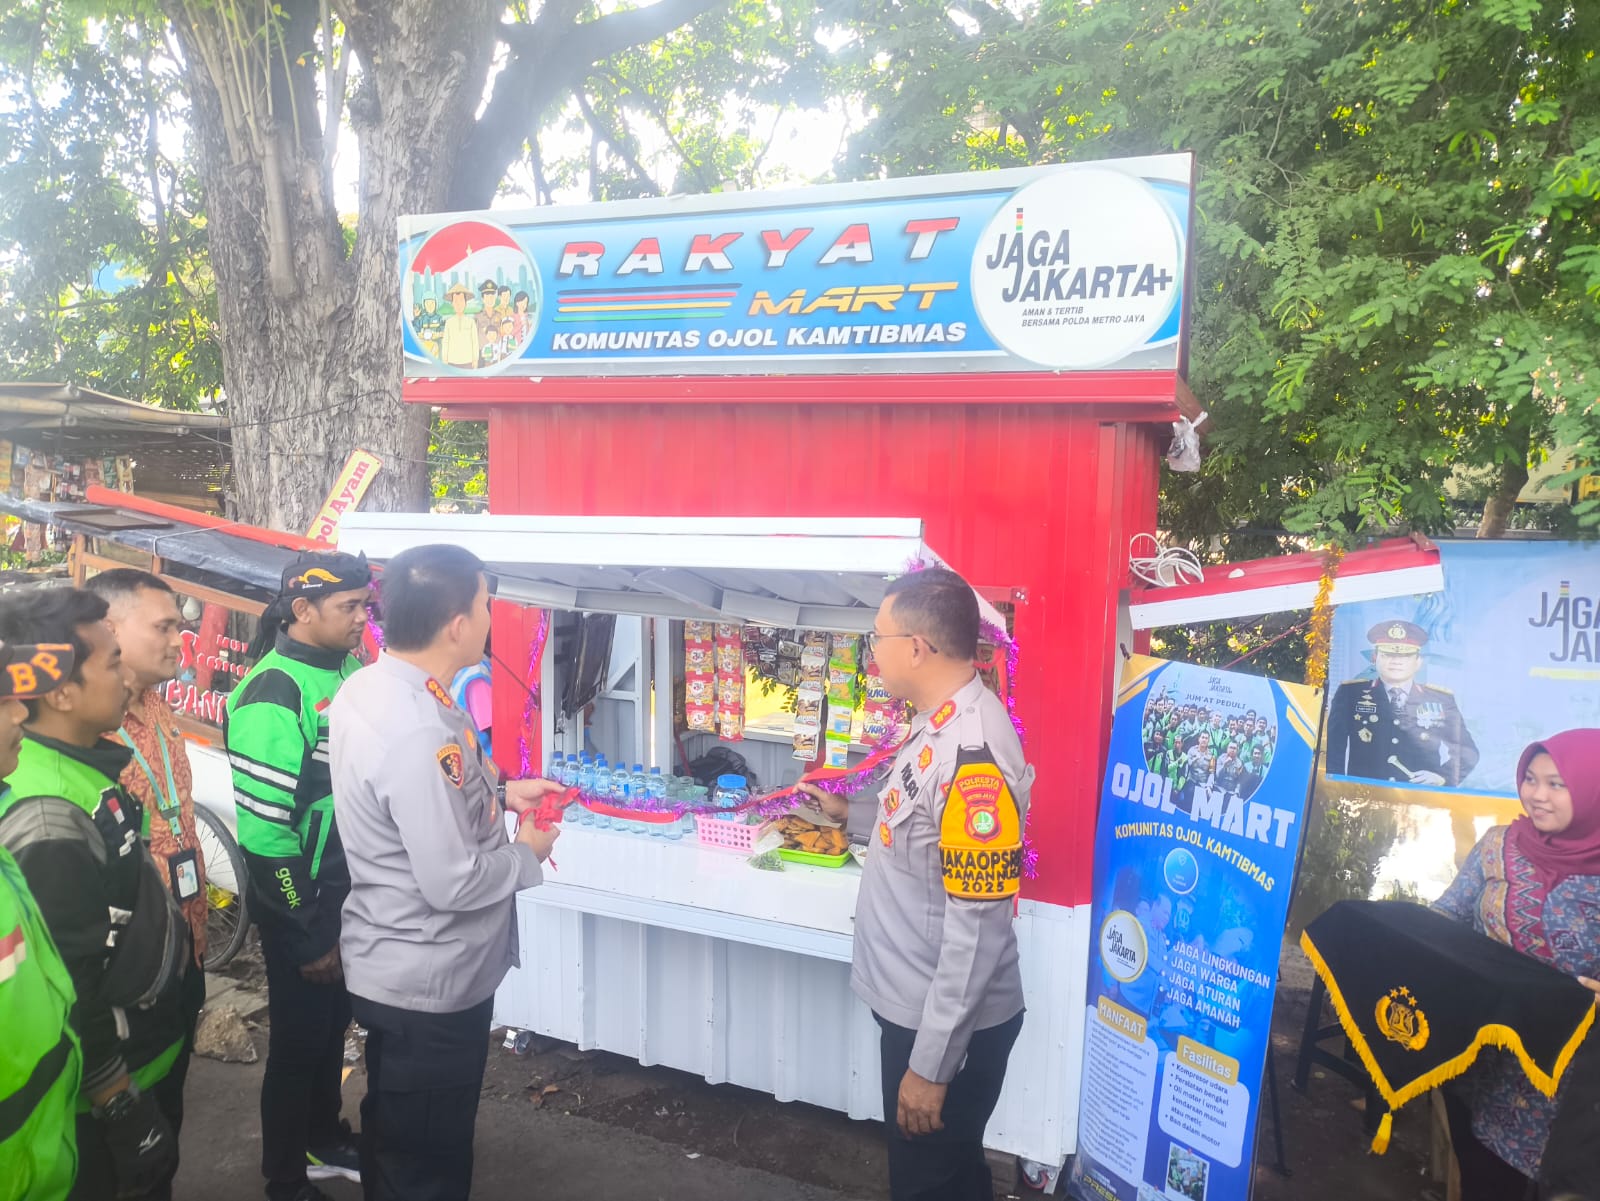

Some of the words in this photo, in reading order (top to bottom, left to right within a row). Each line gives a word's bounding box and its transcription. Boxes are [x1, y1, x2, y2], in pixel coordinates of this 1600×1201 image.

[559, 216, 960, 277] RAKYAT
[986, 229, 1070, 270] JAGA
[748, 281, 959, 316] MART
[1022, 307, 1045, 316] AMAN
[1047, 307, 1053, 316] &
[1055, 306, 1084, 316] TERTIB
[552, 330, 701, 351] KOMUNITAS
[708, 328, 778, 348] OJOL
[786, 322, 967, 346] KAMTIBMAS
[1021, 317, 1060, 327] BERSAMA
[1062, 316, 1090, 326] POLDA
[1092, 315, 1121, 325] METRO
[1123, 314, 1145, 324] JAYA
[329, 461, 370, 515] Ayam
[1216, 699, 1246, 710] PEDULI
[1112, 762, 1177, 815] OJOL
[1190, 785, 1295, 848] MART
[1115, 821, 1173, 839] KOMUNITAS
[1175, 826, 1203, 848] OJOL
[1205, 836, 1275, 892] KAMTIBMAS
[275, 867, 301, 909] gojek
[954, 869, 994, 881] AMAN
[962, 881, 1004, 893] 2025
[1171, 957, 1197, 976] JAGA
[1200, 967, 1238, 993] WARGA
[1173, 941, 1199, 960] JAGA
[1202, 951, 1270, 989] LINGKUNGAN
[1167, 988, 1193, 1008] JAGA
[1195, 1002, 1240, 1028] AMANAH
[1169, 972, 1195, 992] JAGA
[1197, 984, 1240, 1011] ATURAN
[1100, 1003, 1143, 1036] MANFAAT
[1183, 1044, 1231, 1079] Fasilitas
